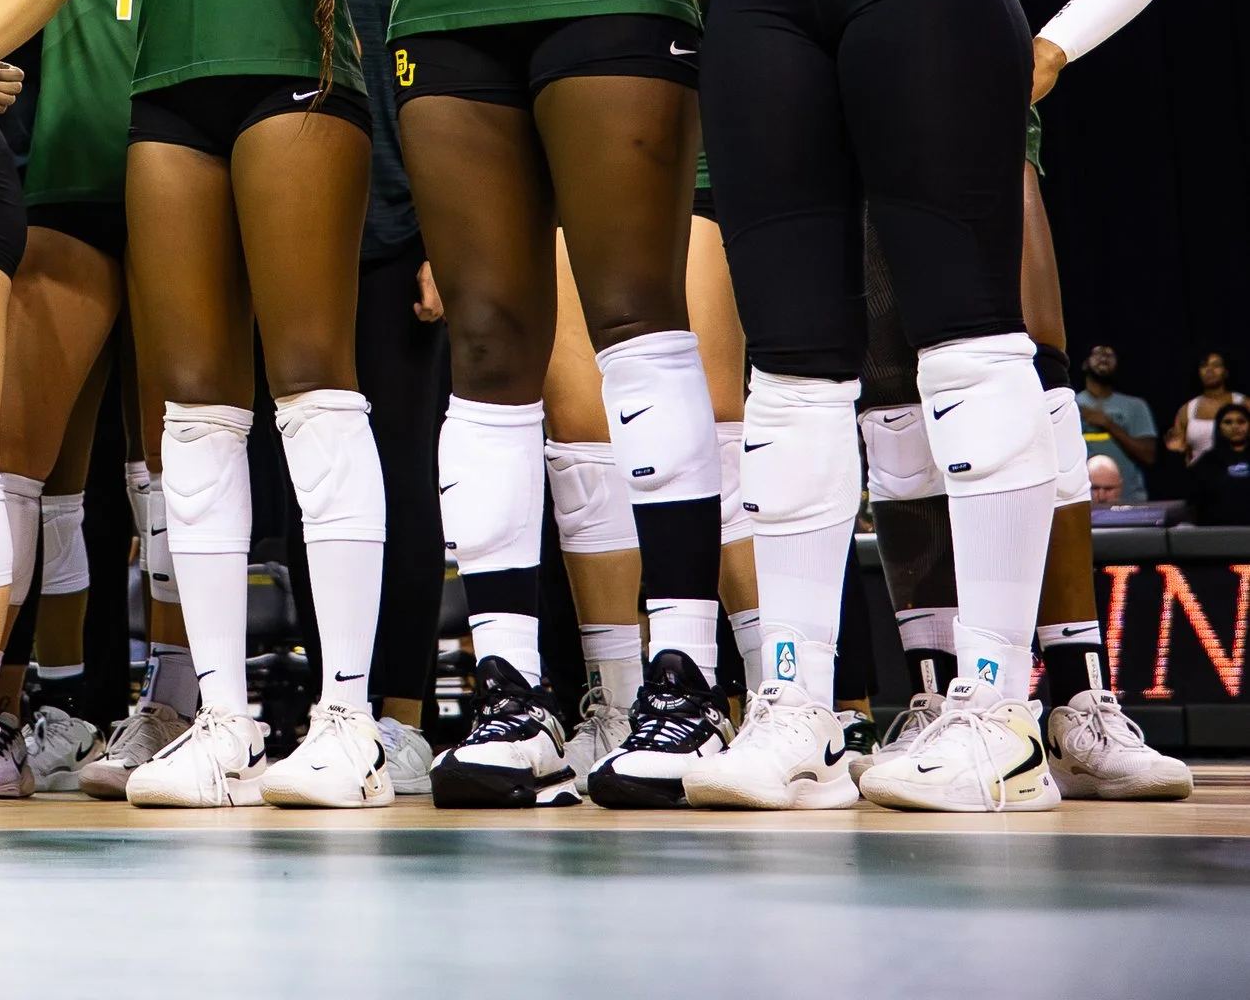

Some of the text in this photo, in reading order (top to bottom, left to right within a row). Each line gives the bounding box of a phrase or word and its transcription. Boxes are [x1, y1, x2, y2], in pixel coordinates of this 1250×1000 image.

[395, 49, 416, 87] BU
[762, 686, 780, 696] NIKE
[952, 684, 973, 695] NIKE
[327, 704, 347, 715] NIKE
